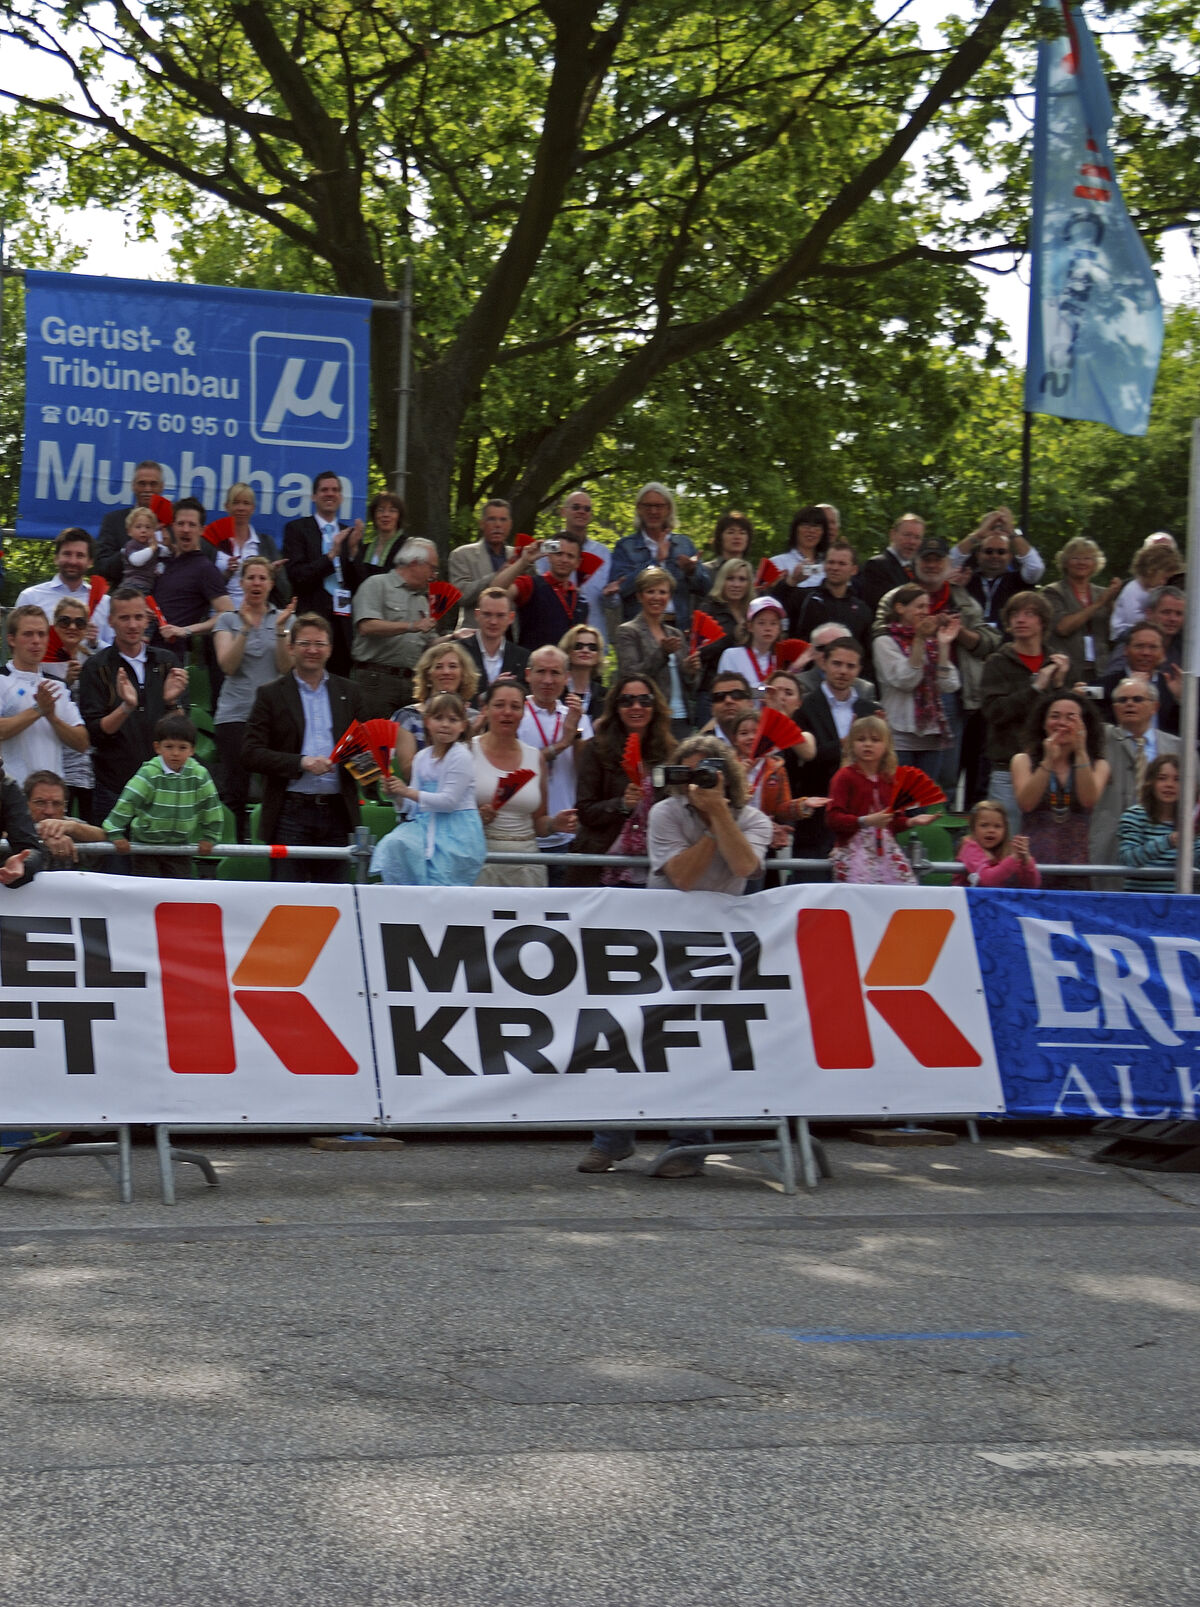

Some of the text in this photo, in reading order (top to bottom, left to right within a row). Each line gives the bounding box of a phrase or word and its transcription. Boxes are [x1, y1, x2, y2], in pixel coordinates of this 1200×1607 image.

[40, 316, 197, 356] Gerüst- &
[41, 355, 240, 400] Tribünenbau
[66, 405, 110, 427] 040
[125, 410, 152, 431] 75
[157, 413, 186, 434] 60
[191, 415, 218, 436] 95
[224, 418, 238, 437] 0
[380, 910, 792, 996] MÖBEL
[388, 1003, 768, 1077] KRAFT
